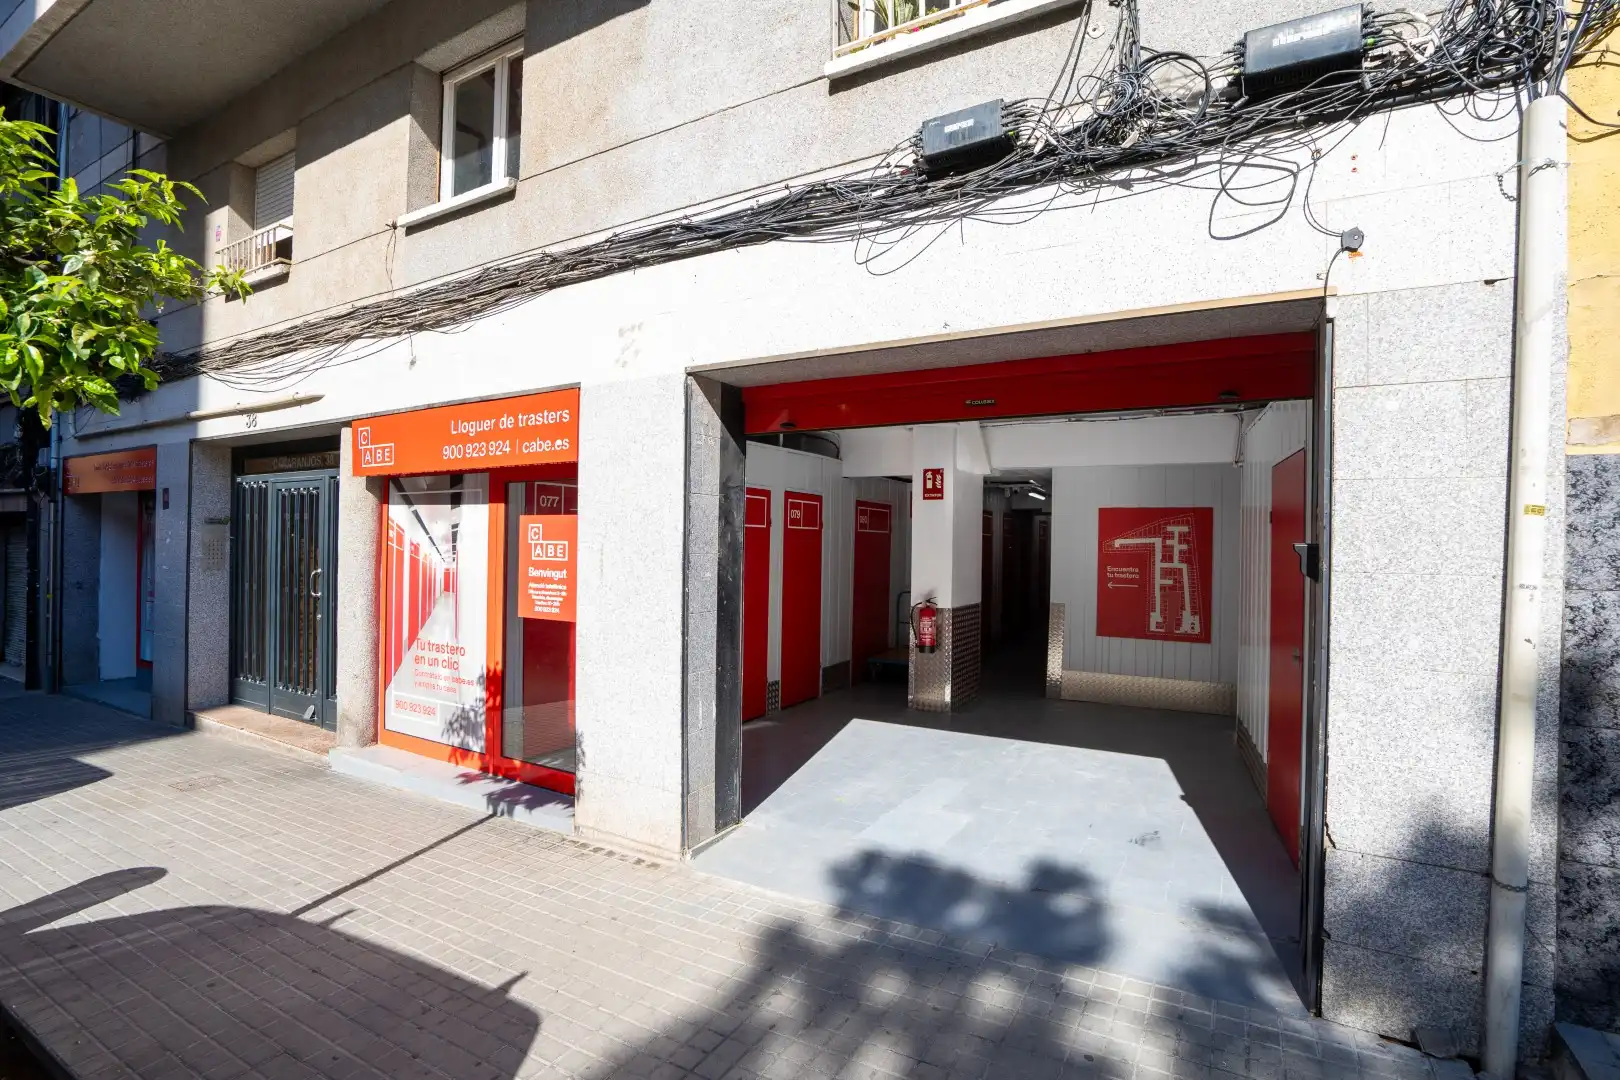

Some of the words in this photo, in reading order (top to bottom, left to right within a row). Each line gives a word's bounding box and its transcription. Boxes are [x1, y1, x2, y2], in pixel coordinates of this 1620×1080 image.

[245, 413, 258, 429] 38
[451, 418, 497, 436] Lloguer
[499, 413, 515, 429] de
[517, 409, 570, 427] trasters
[442, 443, 464, 460] 900
[465, 442, 487, 458] 923
[488, 439, 511, 456] 924
[522, 437, 570, 454] cabe.es
[540, 495, 560, 507] 077
[790, 509, 801, 519] 079
[528, 566, 568, 580] Benvingut
[416, 638, 426, 651] Tu
[427, 640, 466, 656] trastero
[414, 654, 426, 665] en
[428, 656, 439, 667] un
[441, 656, 459, 671] clic
[395, 699, 408, 711] 900
[408, 702, 422, 714] 923
[422, 704, 437, 717] 924
